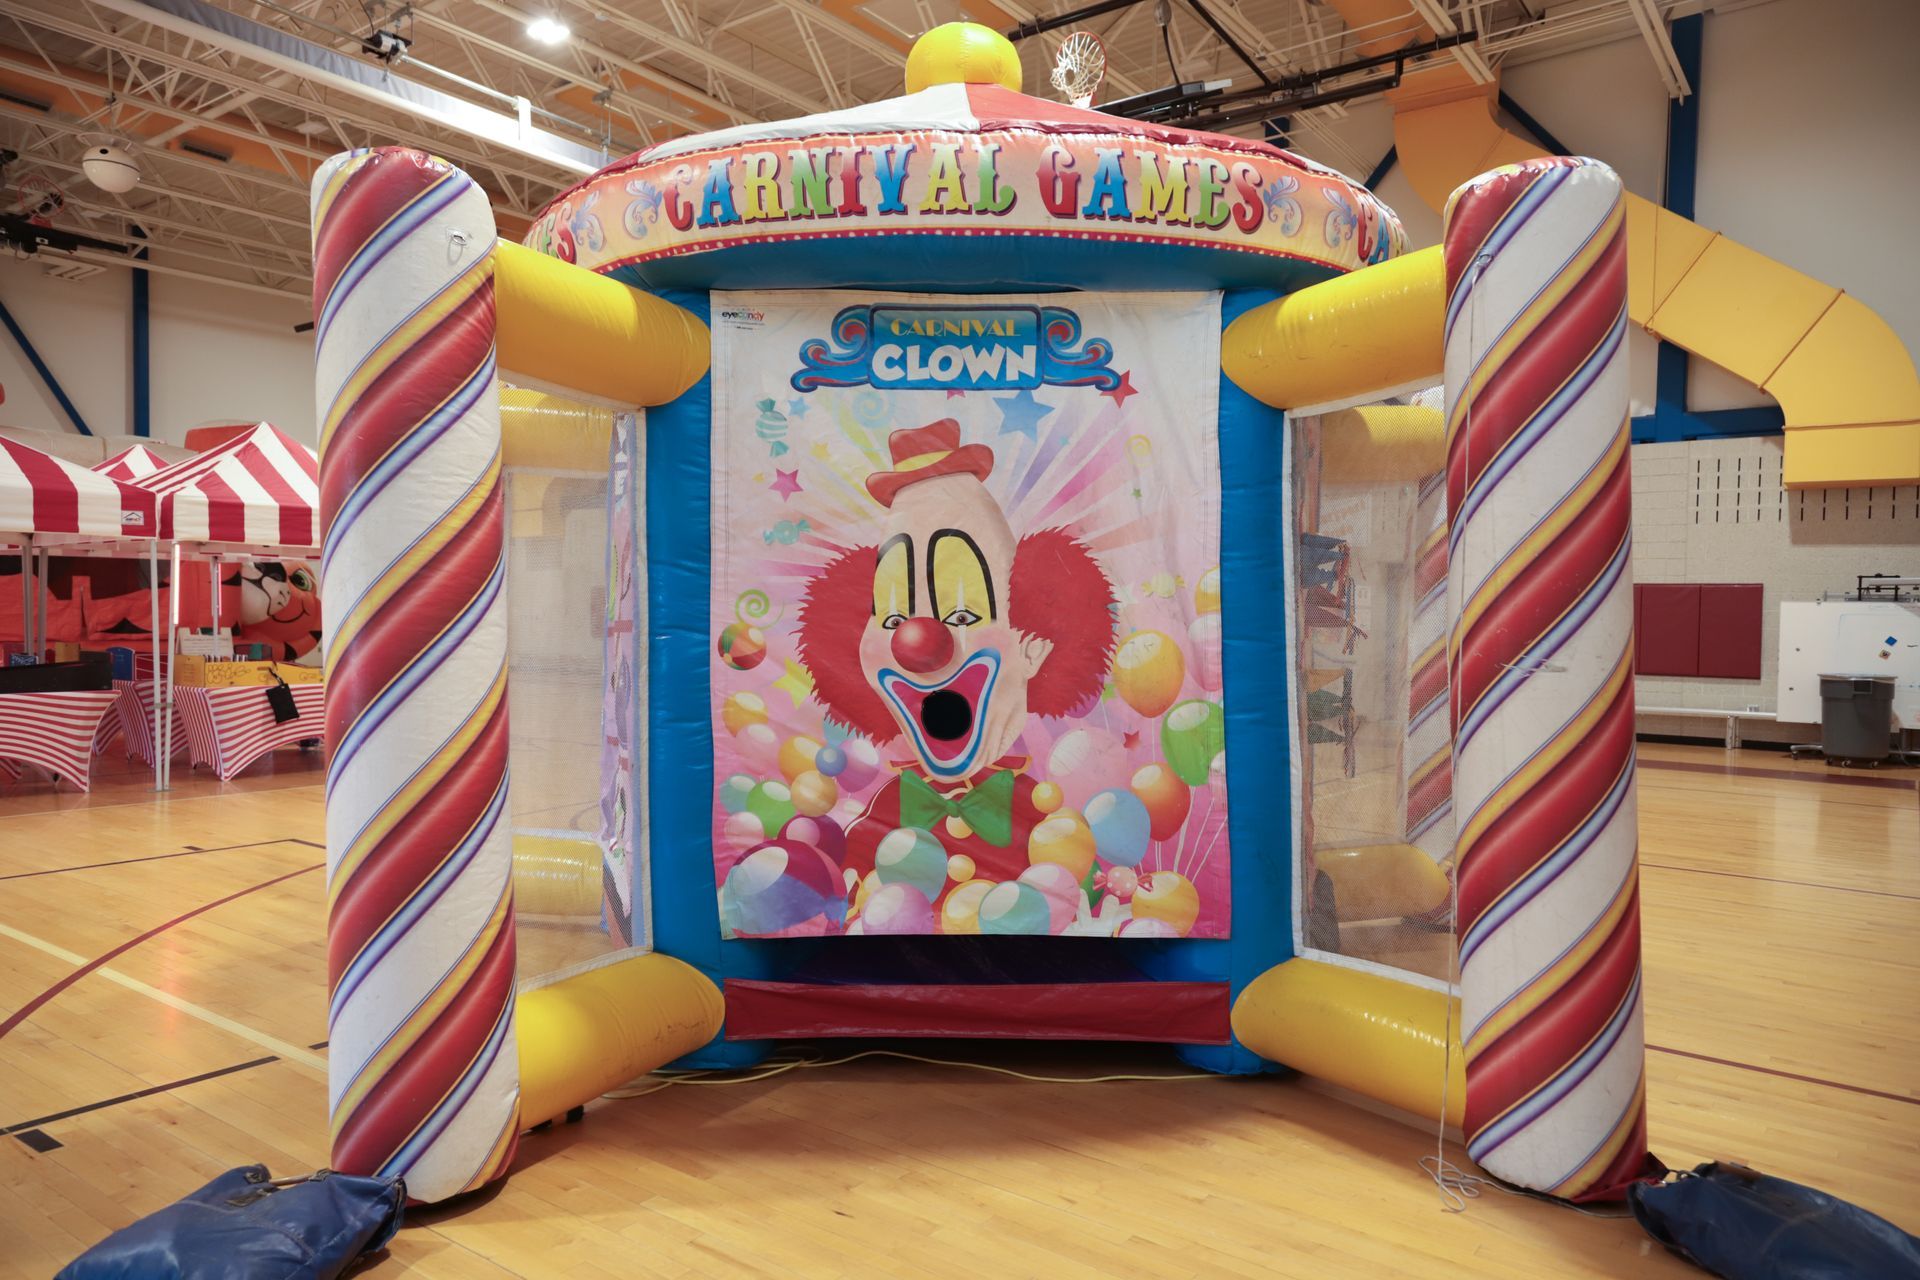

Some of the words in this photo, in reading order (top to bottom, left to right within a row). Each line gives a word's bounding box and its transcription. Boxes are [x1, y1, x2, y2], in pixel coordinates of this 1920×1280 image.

[662, 142, 1017, 231] CARNIVAL
[1036, 143, 1264, 234] GAMES
[890, 319, 1021, 337] CARNIVAL
[872, 343, 1037, 384] CLOWN
